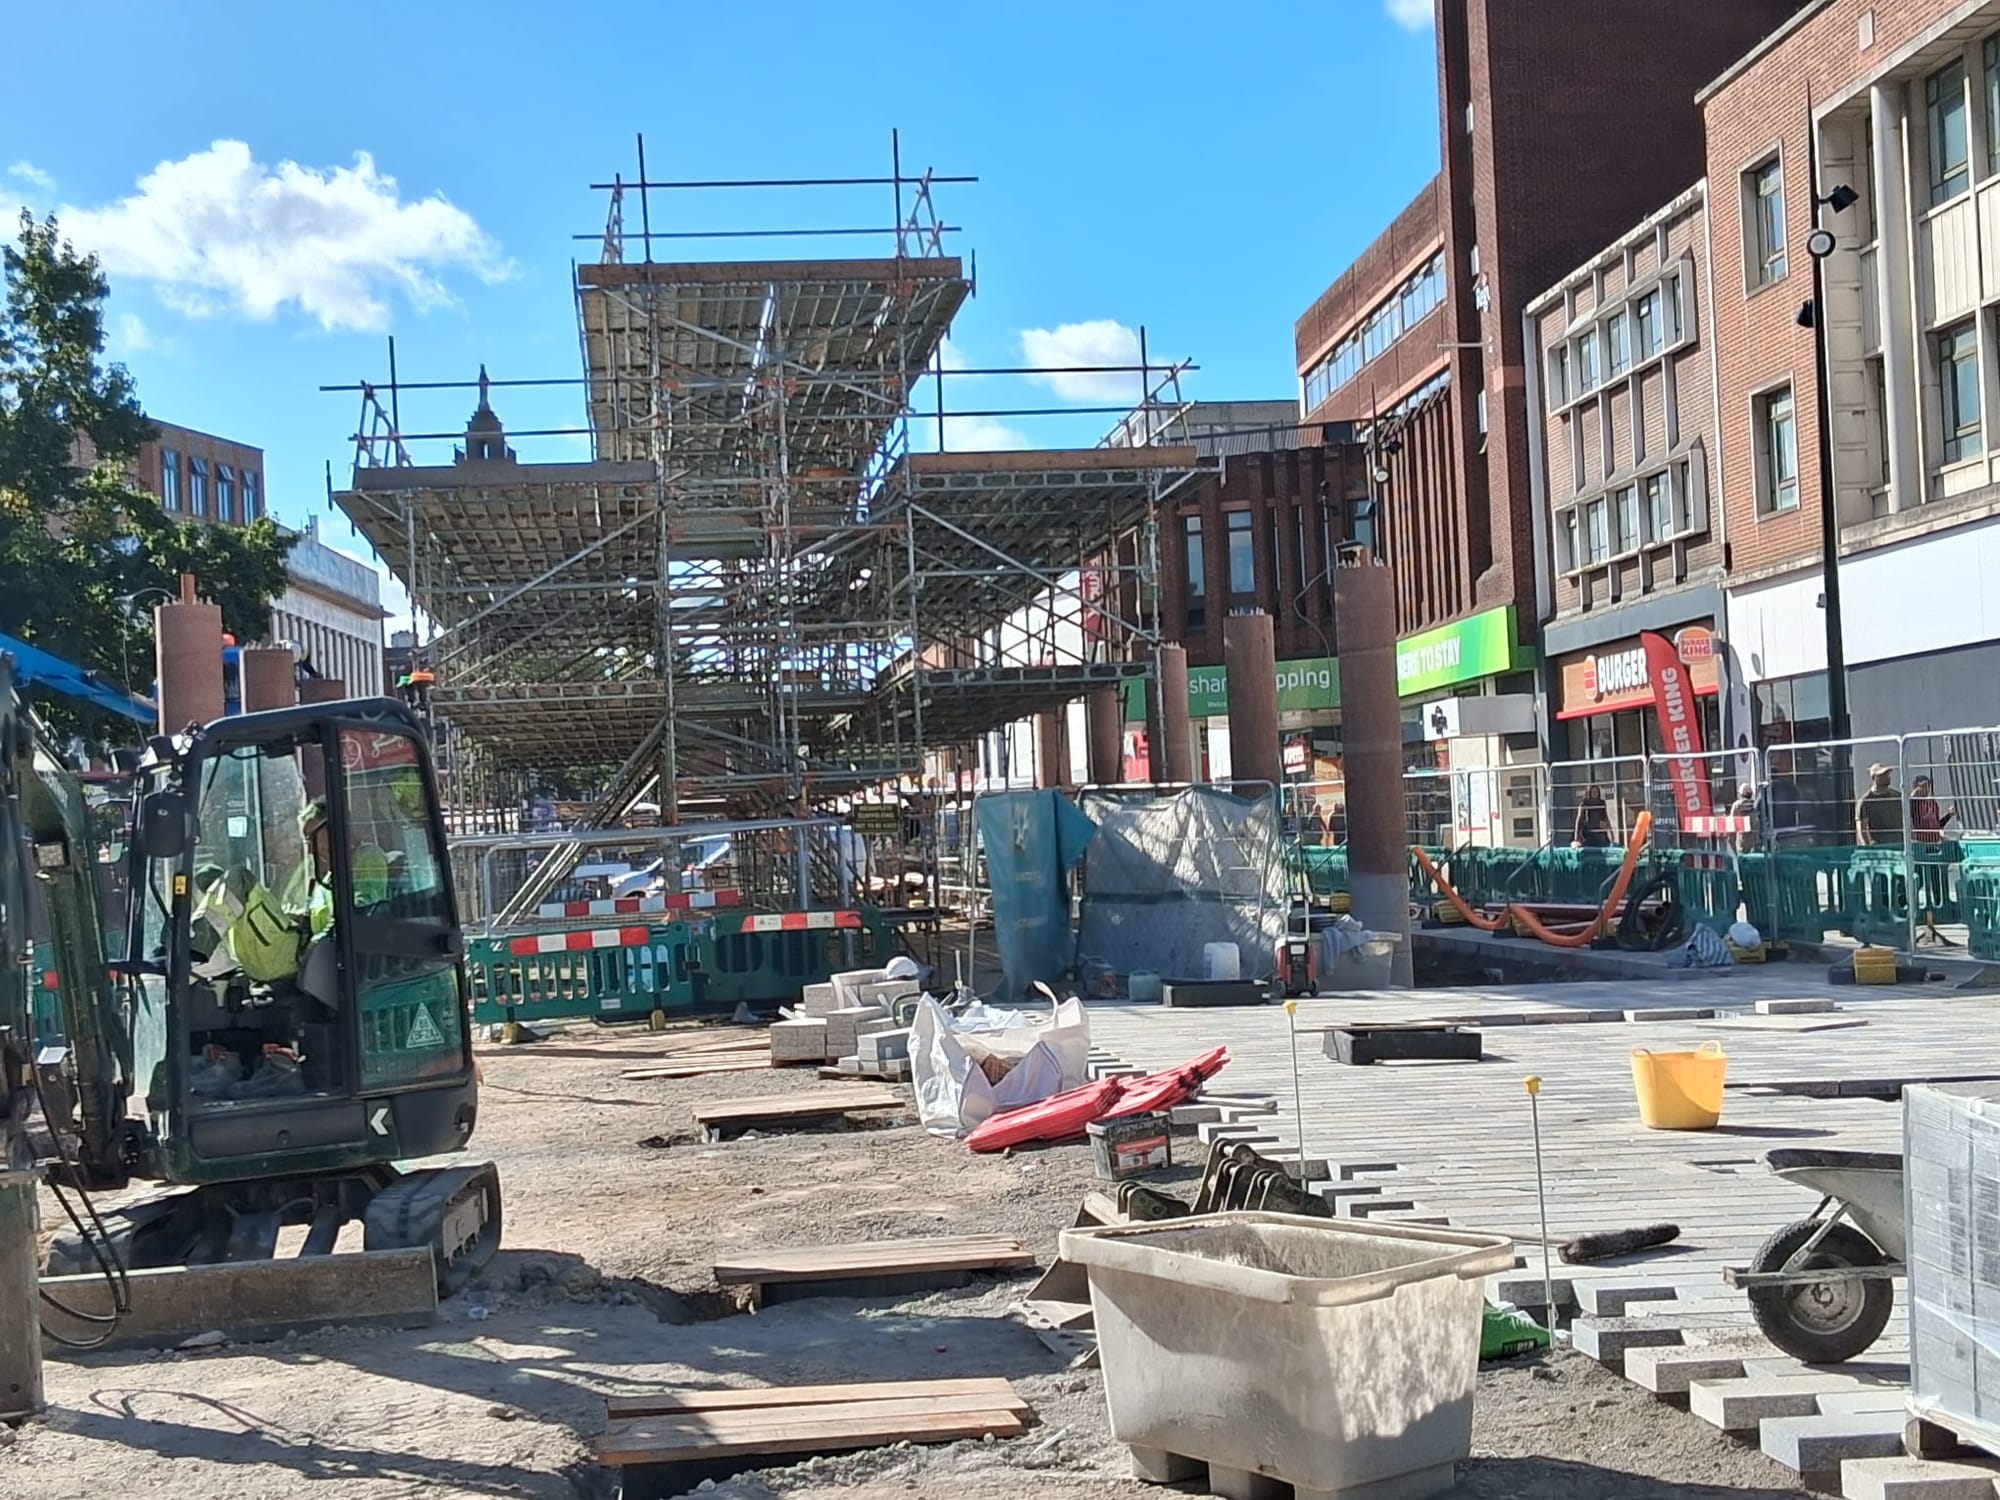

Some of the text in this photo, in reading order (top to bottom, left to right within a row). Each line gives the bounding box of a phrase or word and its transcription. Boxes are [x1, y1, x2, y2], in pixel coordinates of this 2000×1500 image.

[1420, 644, 1434, 674] TO
[1434, 635, 1461, 669] STAY
[1598, 647, 1648, 693] BURGER
[1681, 646, 1710, 655] KING
[1275, 667, 1330, 693] pping
[1661, 667, 1701, 812] BURGER KING
